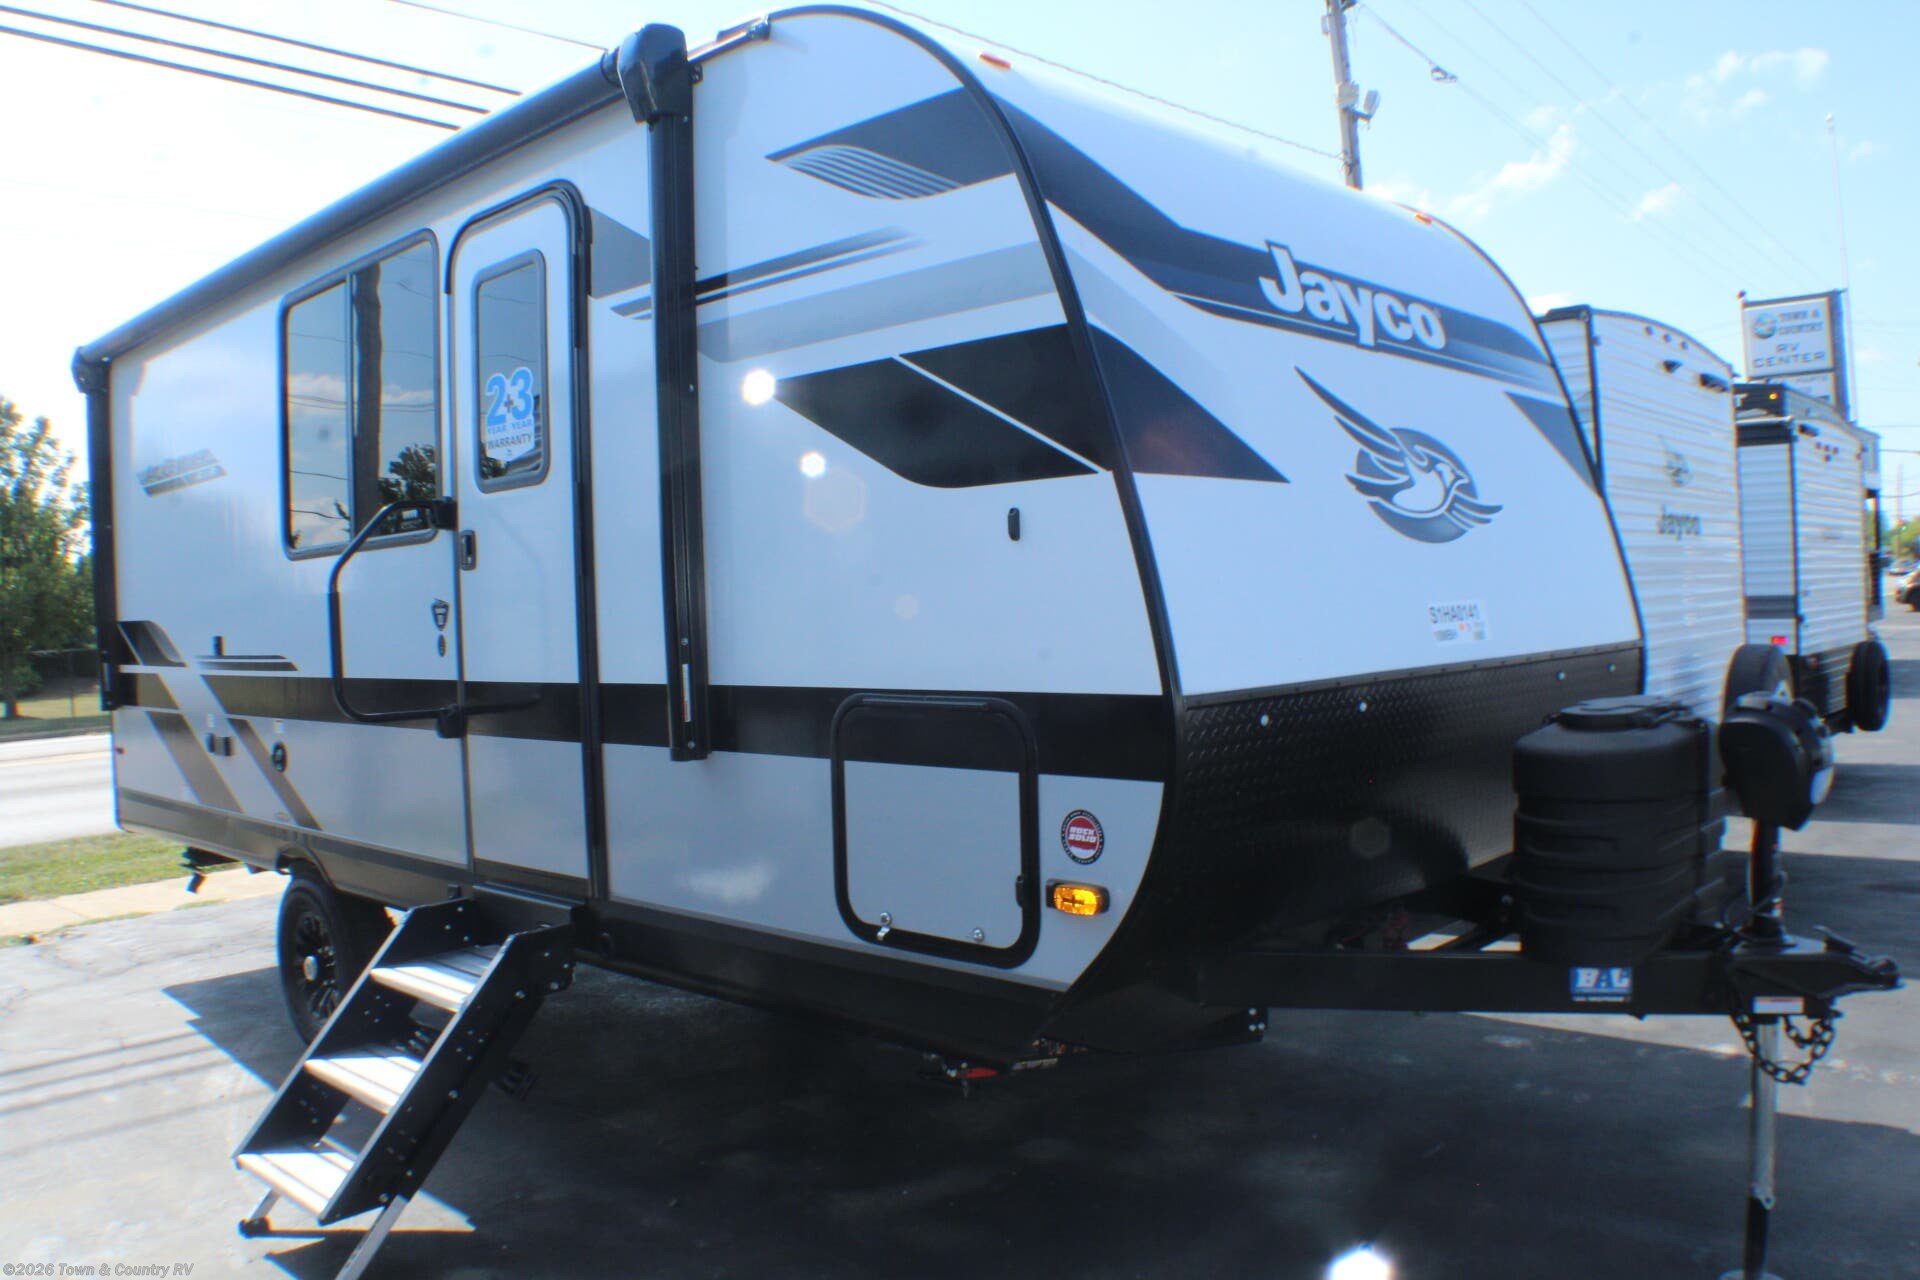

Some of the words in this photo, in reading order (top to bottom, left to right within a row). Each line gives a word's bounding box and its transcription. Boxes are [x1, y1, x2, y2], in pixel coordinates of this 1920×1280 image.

[1257, 239, 1447, 350] Jayco
[1776, 342, 1799, 353] RV
[1752, 351, 1826, 368] CENTER
[487, 433, 533, 450] WARRANTY
[1656, 504, 1701, 540] Jayco
[1070, 826, 1095, 836] ROCK
